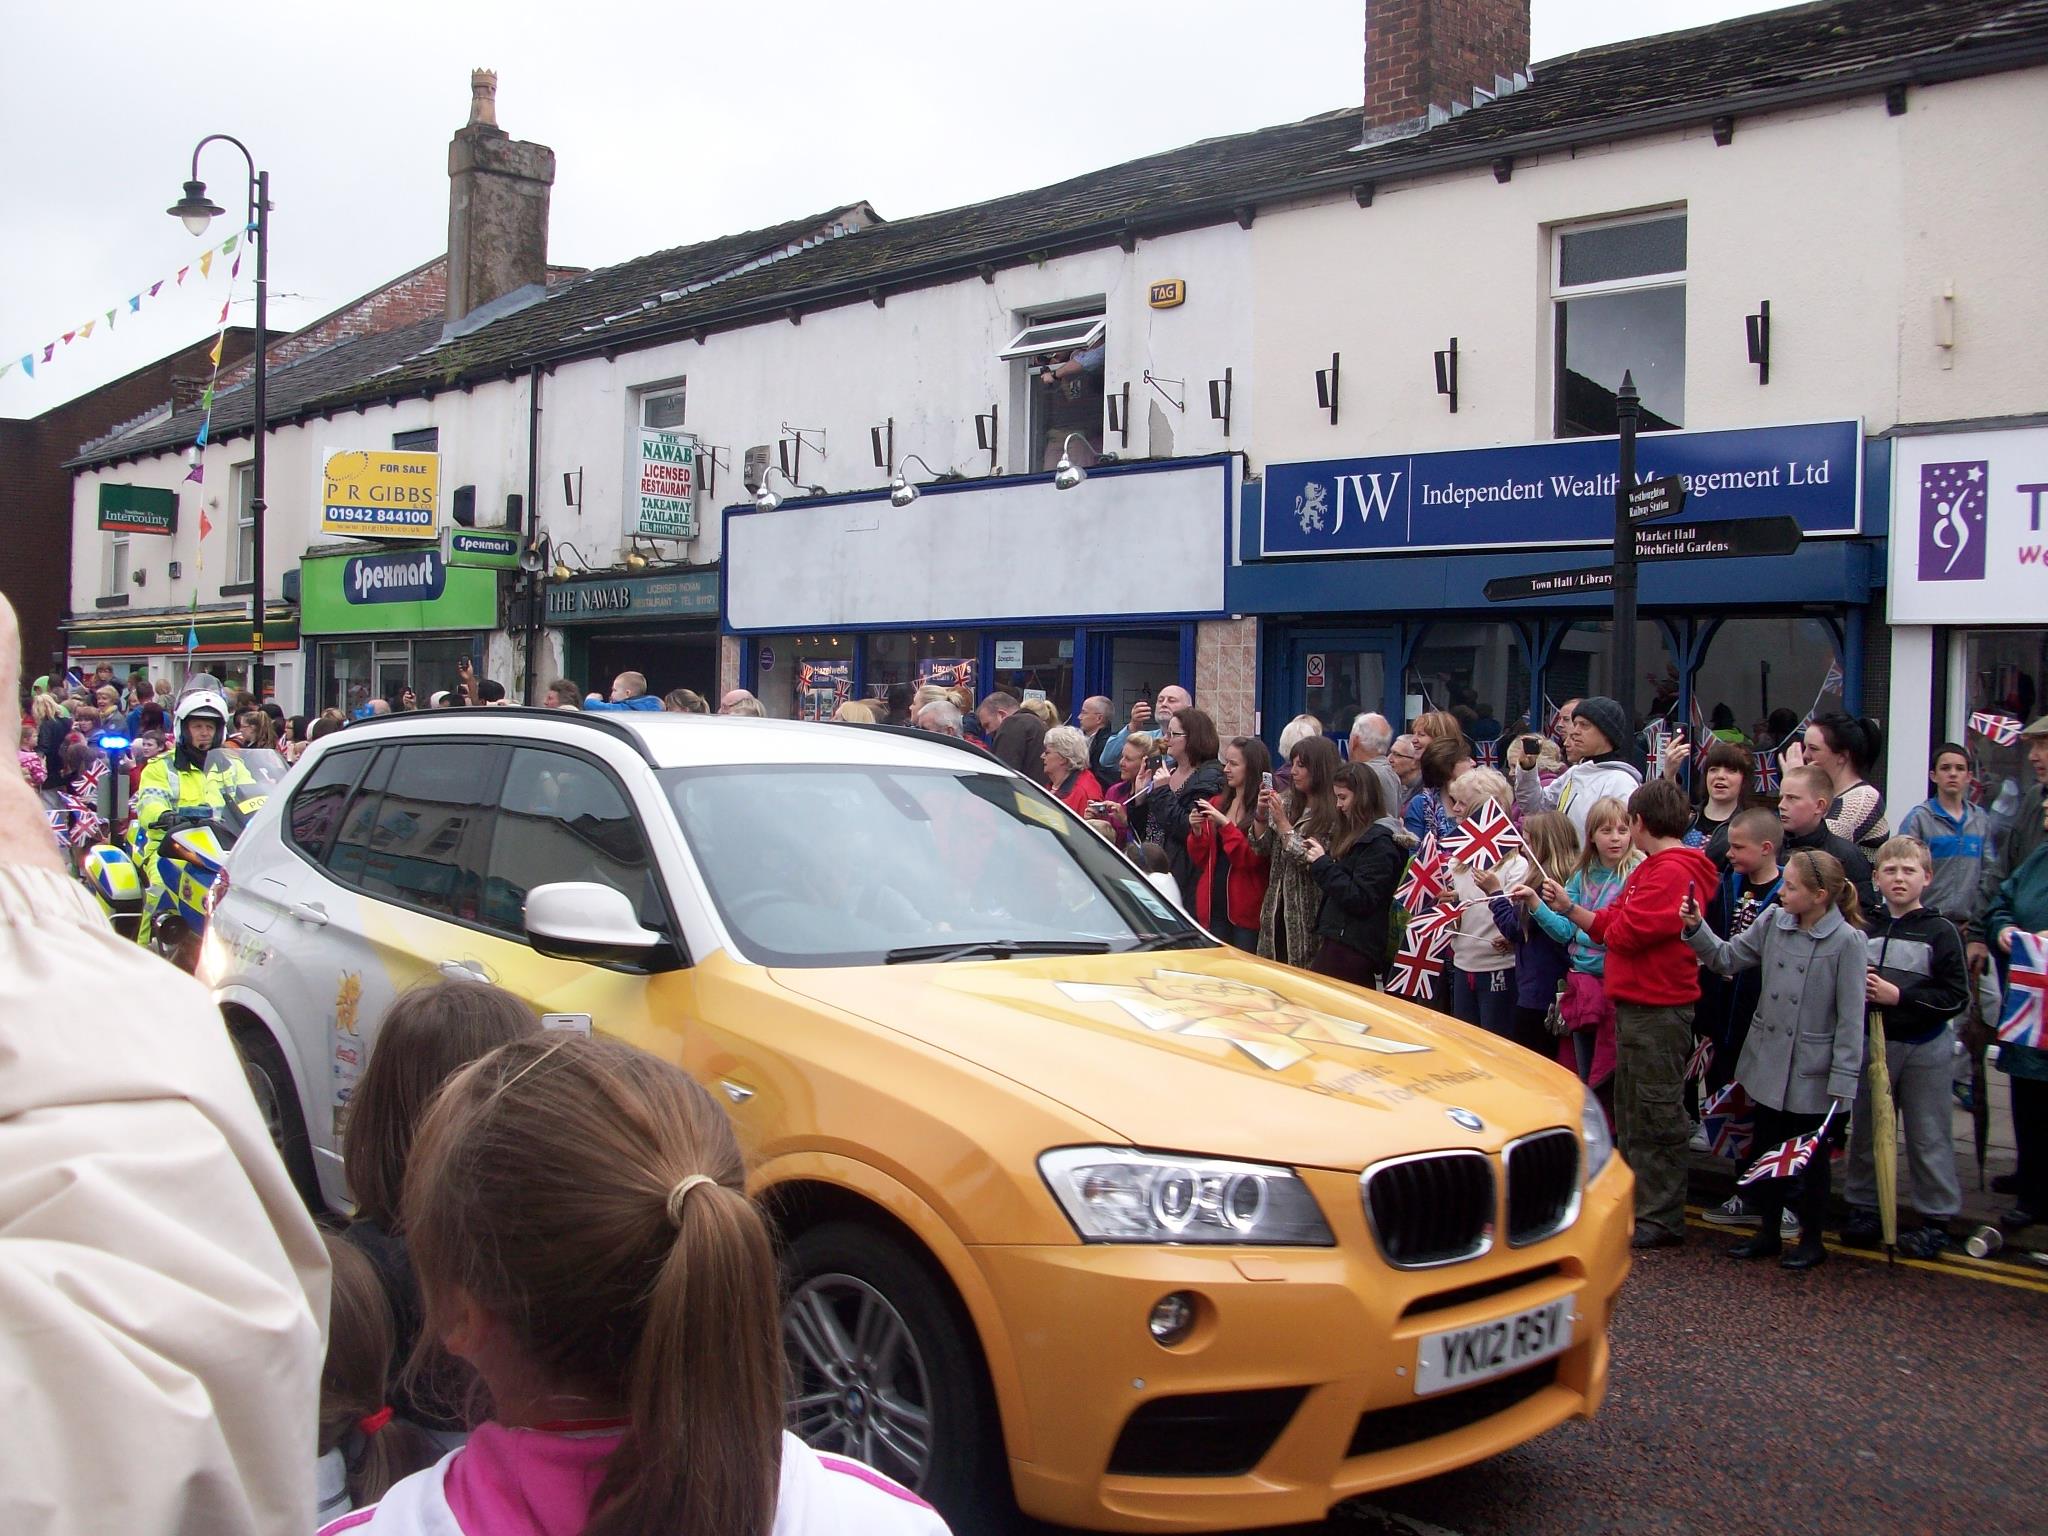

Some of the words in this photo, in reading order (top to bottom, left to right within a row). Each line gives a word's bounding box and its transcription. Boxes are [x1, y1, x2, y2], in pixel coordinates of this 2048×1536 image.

[1152, 285, 1175, 301] TAG
[659, 434, 679, 444] THE
[642, 442, 693, 463] NAWAB
[380, 464, 400, 473] FOR
[402, 465, 428, 474] SALE
[643, 463, 691, 483] LICENSED
[327, 483, 339, 499] P
[347, 484, 361, 501] R
[369, 486, 433, 504] GIBBS
[640, 478, 692, 498] RESTAURANT
[1421, 478, 1544, 510] Independent
[1550, 473, 1621, 498] Wealth
[1634, 467, 1781, 497] Magement
[1787, 459, 1830, 486] Ltd
[641, 497, 692, 514] TAKEAWAY
[1332, 471, 1403, 536] JW
[1629, 505, 1649, 518] Railway
[1649, 500, 1670, 513] Station
[105, 510, 169, 528] Intercounty
[329, 507, 373, 521] 01942
[376, 510, 430, 524] 844100
[640, 509, 691, 525] AVAILABLE
[460, 537, 510, 552] Spexmart
[1635, 530, 1672, 543] Market
[1674, 528, 1697, 540] Hall
[1635, 542, 1685, 556] Ditchfield
[1686, 540, 1730, 554] Gardens
[355, 554, 433, 599] Spexmart
[1531, 579, 1553, 591] Town
[1553, 576, 1573, 588] Hall
[1580, 573, 1613, 586] Library
[550, 590, 577, 613] THE
[580, 587, 631, 610] NAWAB
[1441, 1322, 1507, 1378] YK12
